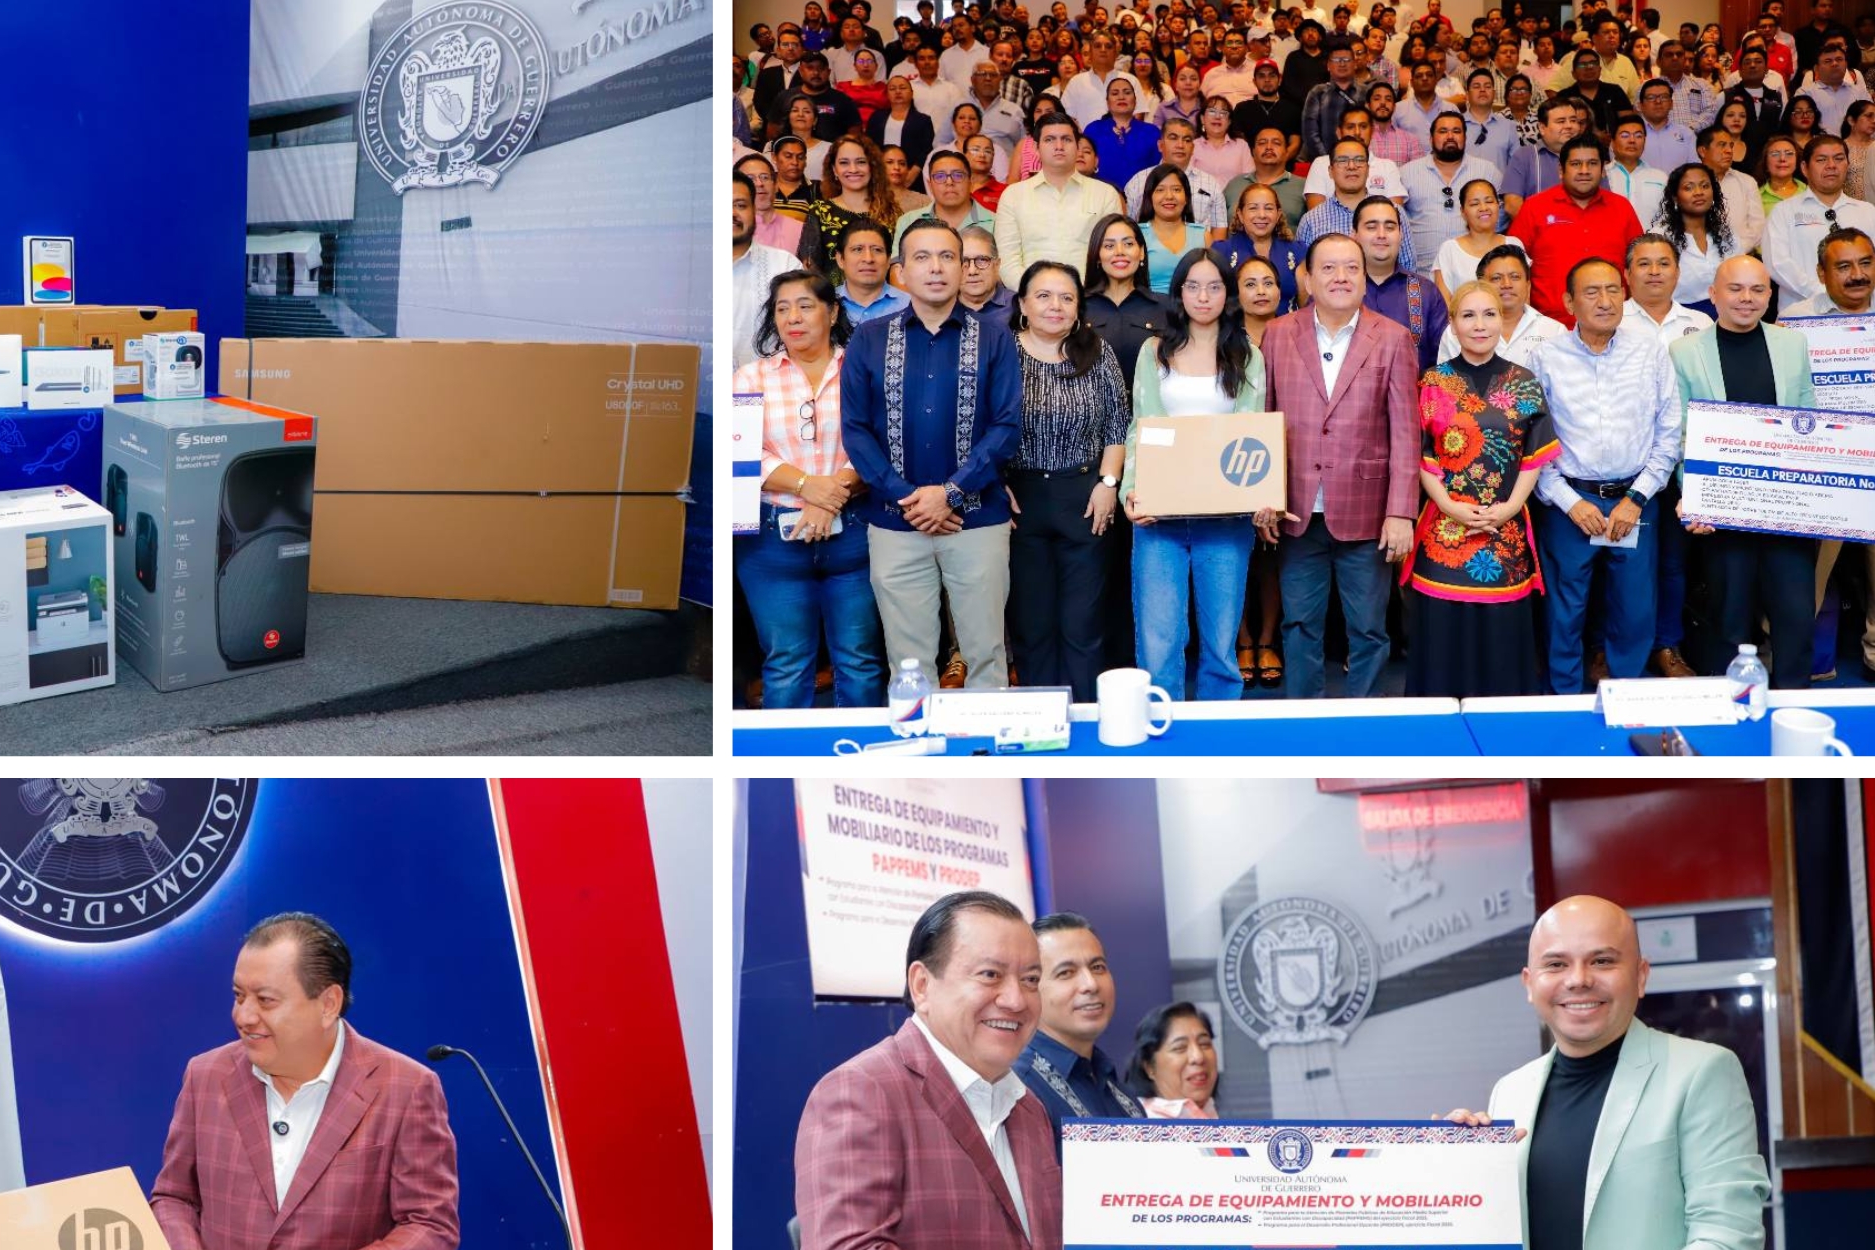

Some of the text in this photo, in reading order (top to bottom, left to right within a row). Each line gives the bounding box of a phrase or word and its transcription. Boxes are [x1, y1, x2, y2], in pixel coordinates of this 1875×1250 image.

[367, 6, 539, 166] UNIVERSIDAD AUTÓNOMA DE GUERRERO
[658, 380, 684, 390] UHD
[1814, 375, 1862, 385] ESCUELA
[193, 434, 227, 444] Steren
[1705, 437, 1846, 455] ENTREGA DE EQUIPAMIENTO Y
[1220, 436, 1271, 487] hp
[1717, 466, 1856, 488] ESCUELA PREPARATORIA
[834, 786, 999, 840] ENTREGA DE EQUIPAMIENTO Y
[827, 814, 1009, 868] MOBILIARIO DE LOS PROGRAMAS
[60, 898, 105, 924] DE
[1234, 1174, 1347, 1183] UNIVERSIDAD AUTÓNOMA
[1100, 1194, 1483, 1210] ENTREGA DE EQUIPAMIENTO Y MOBILIARIO
[1132, 1214, 1147, 1222] DE
[1176, 1215, 1252, 1223] PROGRAMAS:
